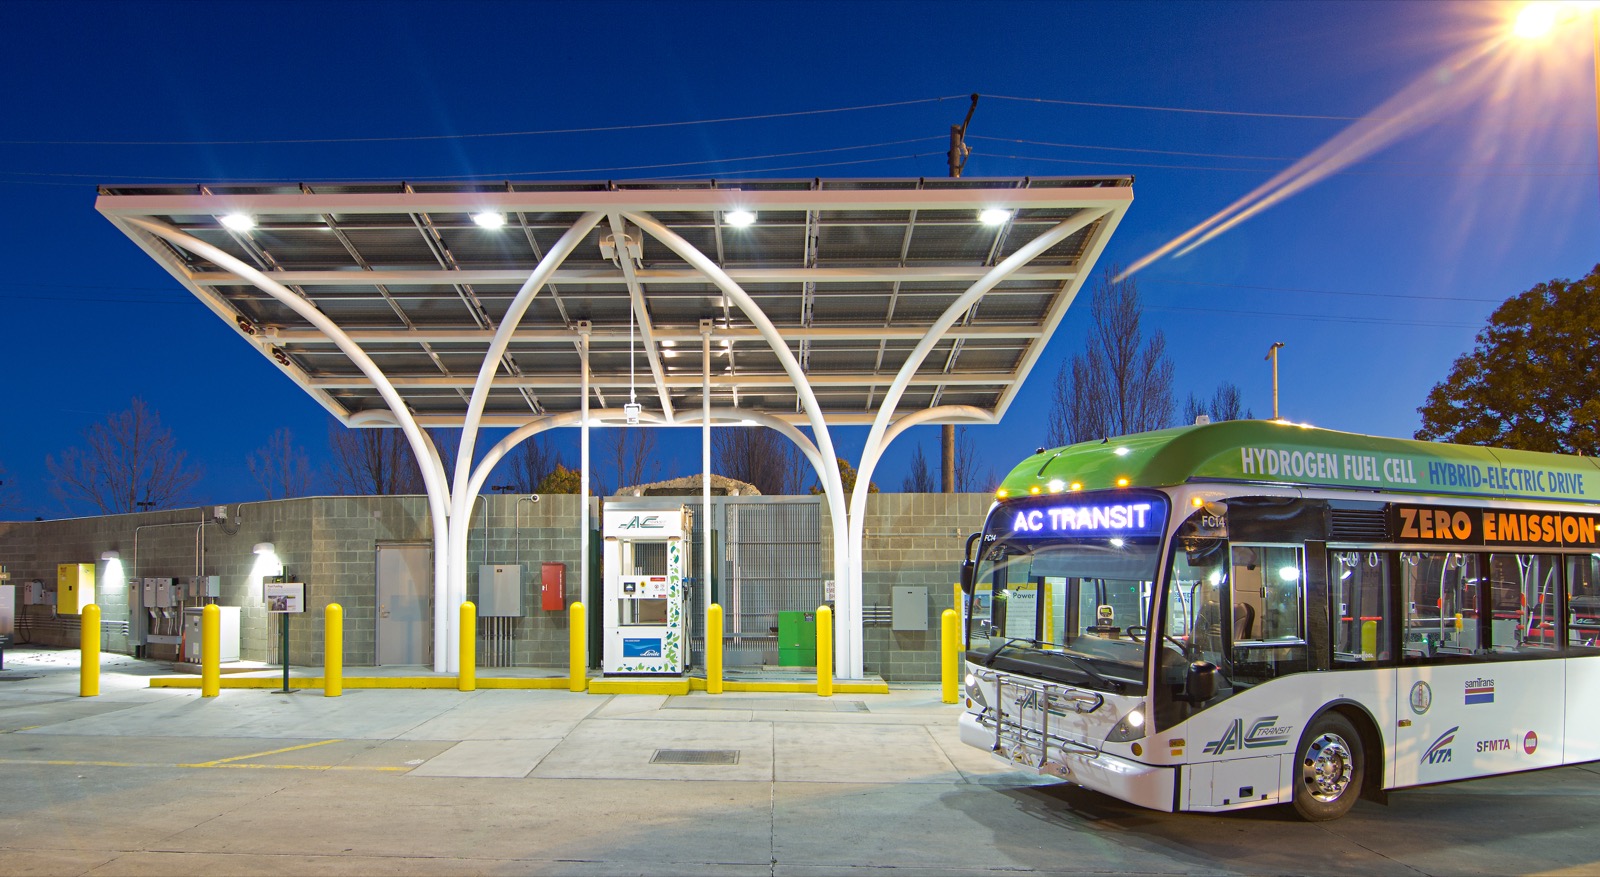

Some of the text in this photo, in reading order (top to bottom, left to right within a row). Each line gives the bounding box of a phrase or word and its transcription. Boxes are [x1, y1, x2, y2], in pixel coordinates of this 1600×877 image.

[1241, 447, 1585, 495] HYDROGEN FUEL CELL HYBRID-ELECTRIC DRIVE
[1013, 504, 1150, 532] AC TRANSIT
[1202, 515, 1226, 528] FC14
[1400, 508, 1596, 544] ZERO EMISSION
[640, 649, 660, 657] Linde
[1464, 677, 1495, 689] samTrans
[1202, 715, 1293, 755] AC TRANSIT
[1476, 739, 1511, 752] SFMTA
[1428, 748, 1452, 764] VTA
